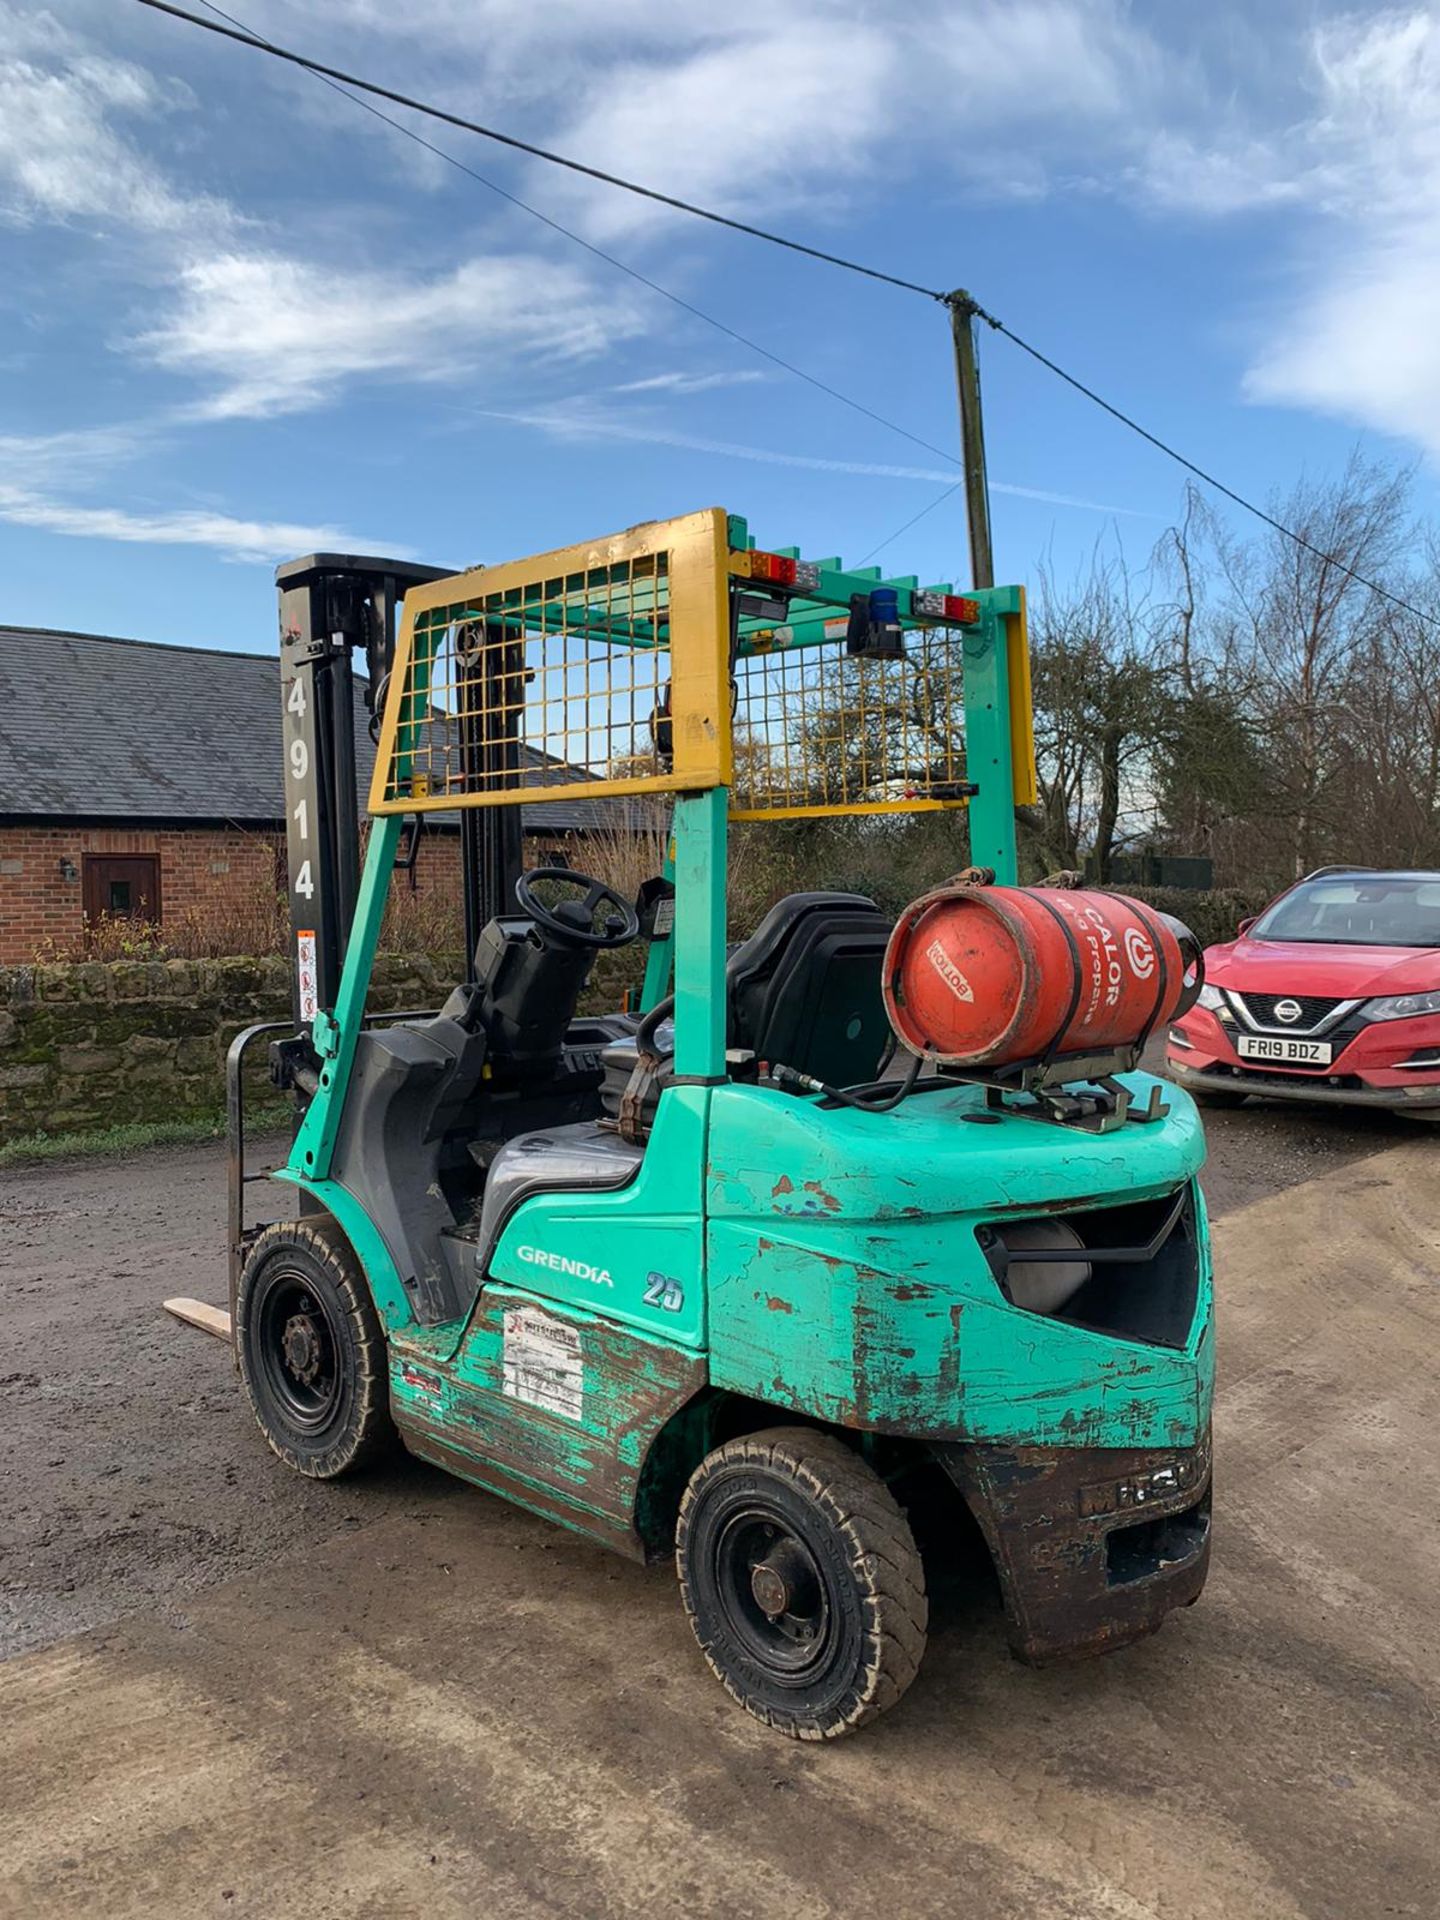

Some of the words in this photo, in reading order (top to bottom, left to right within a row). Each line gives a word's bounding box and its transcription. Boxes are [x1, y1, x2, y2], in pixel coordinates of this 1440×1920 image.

[929, 942, 969, 996] BOTTOM
[1084, 908, 1121, 1005] CALOR
[1248, 1040, 1283, 1056] FR19
[1287, 1043, 1320, 1060] BDZ
[517, 1245, 614, 1288] GRENDIA
[643, 1271, 685, 1313] 25
